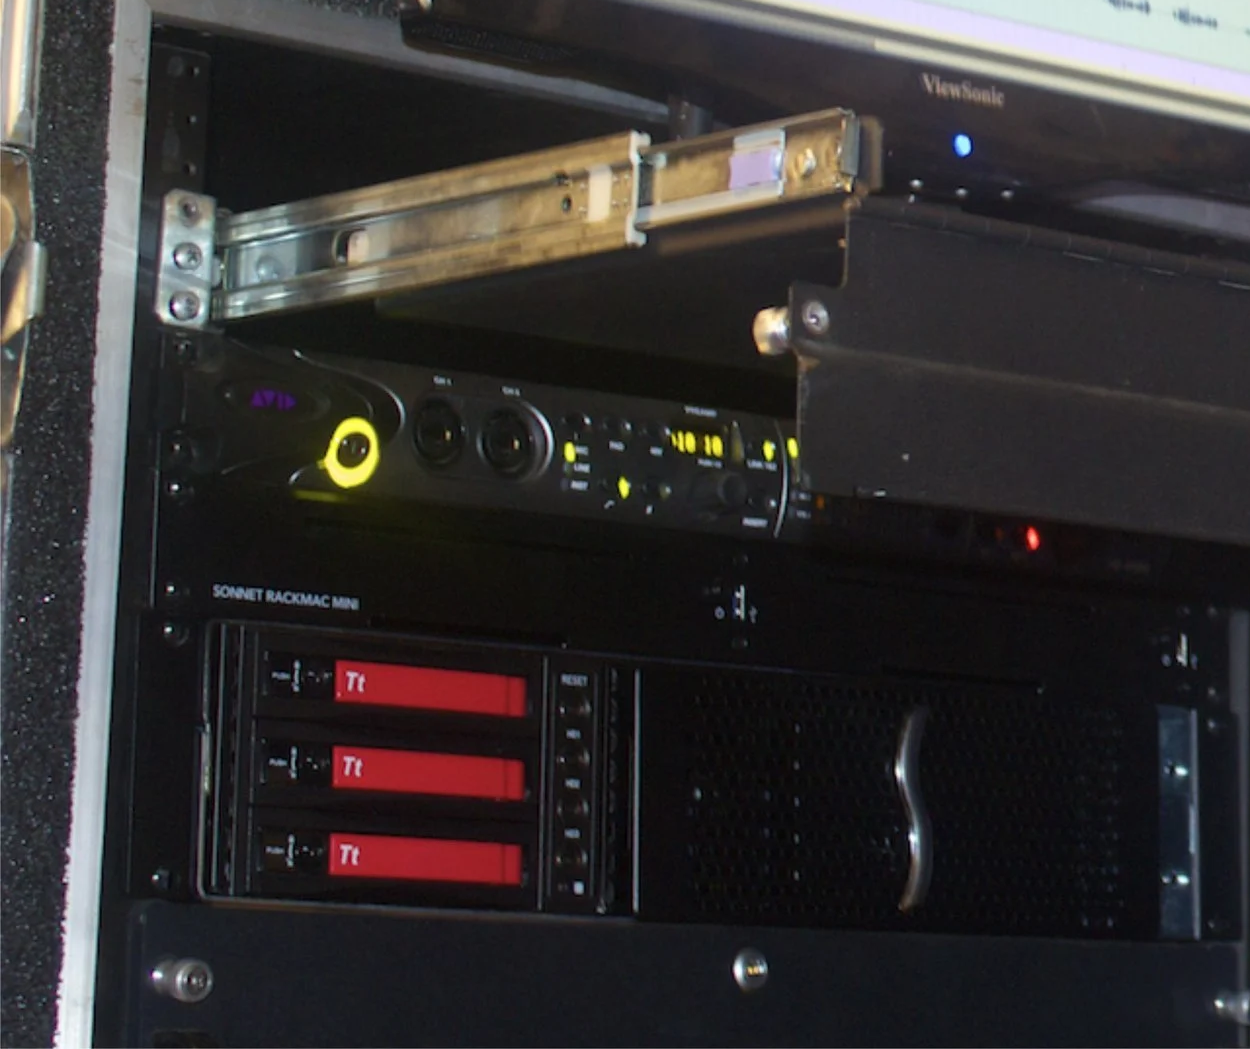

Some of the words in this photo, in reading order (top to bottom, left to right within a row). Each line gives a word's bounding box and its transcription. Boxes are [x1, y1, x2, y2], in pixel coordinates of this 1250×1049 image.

[922, 71, 1004, 109] ViewSonic
[212, 583, 264, 602] SONNET
[265, 589, 331, 609] RACKMAC
[331, 595, 360, 611] MINI
[345, 671, 366, 693] Tt
[343, 756, 364, 777] Tt
[339, 844, 361, 866] Tt
